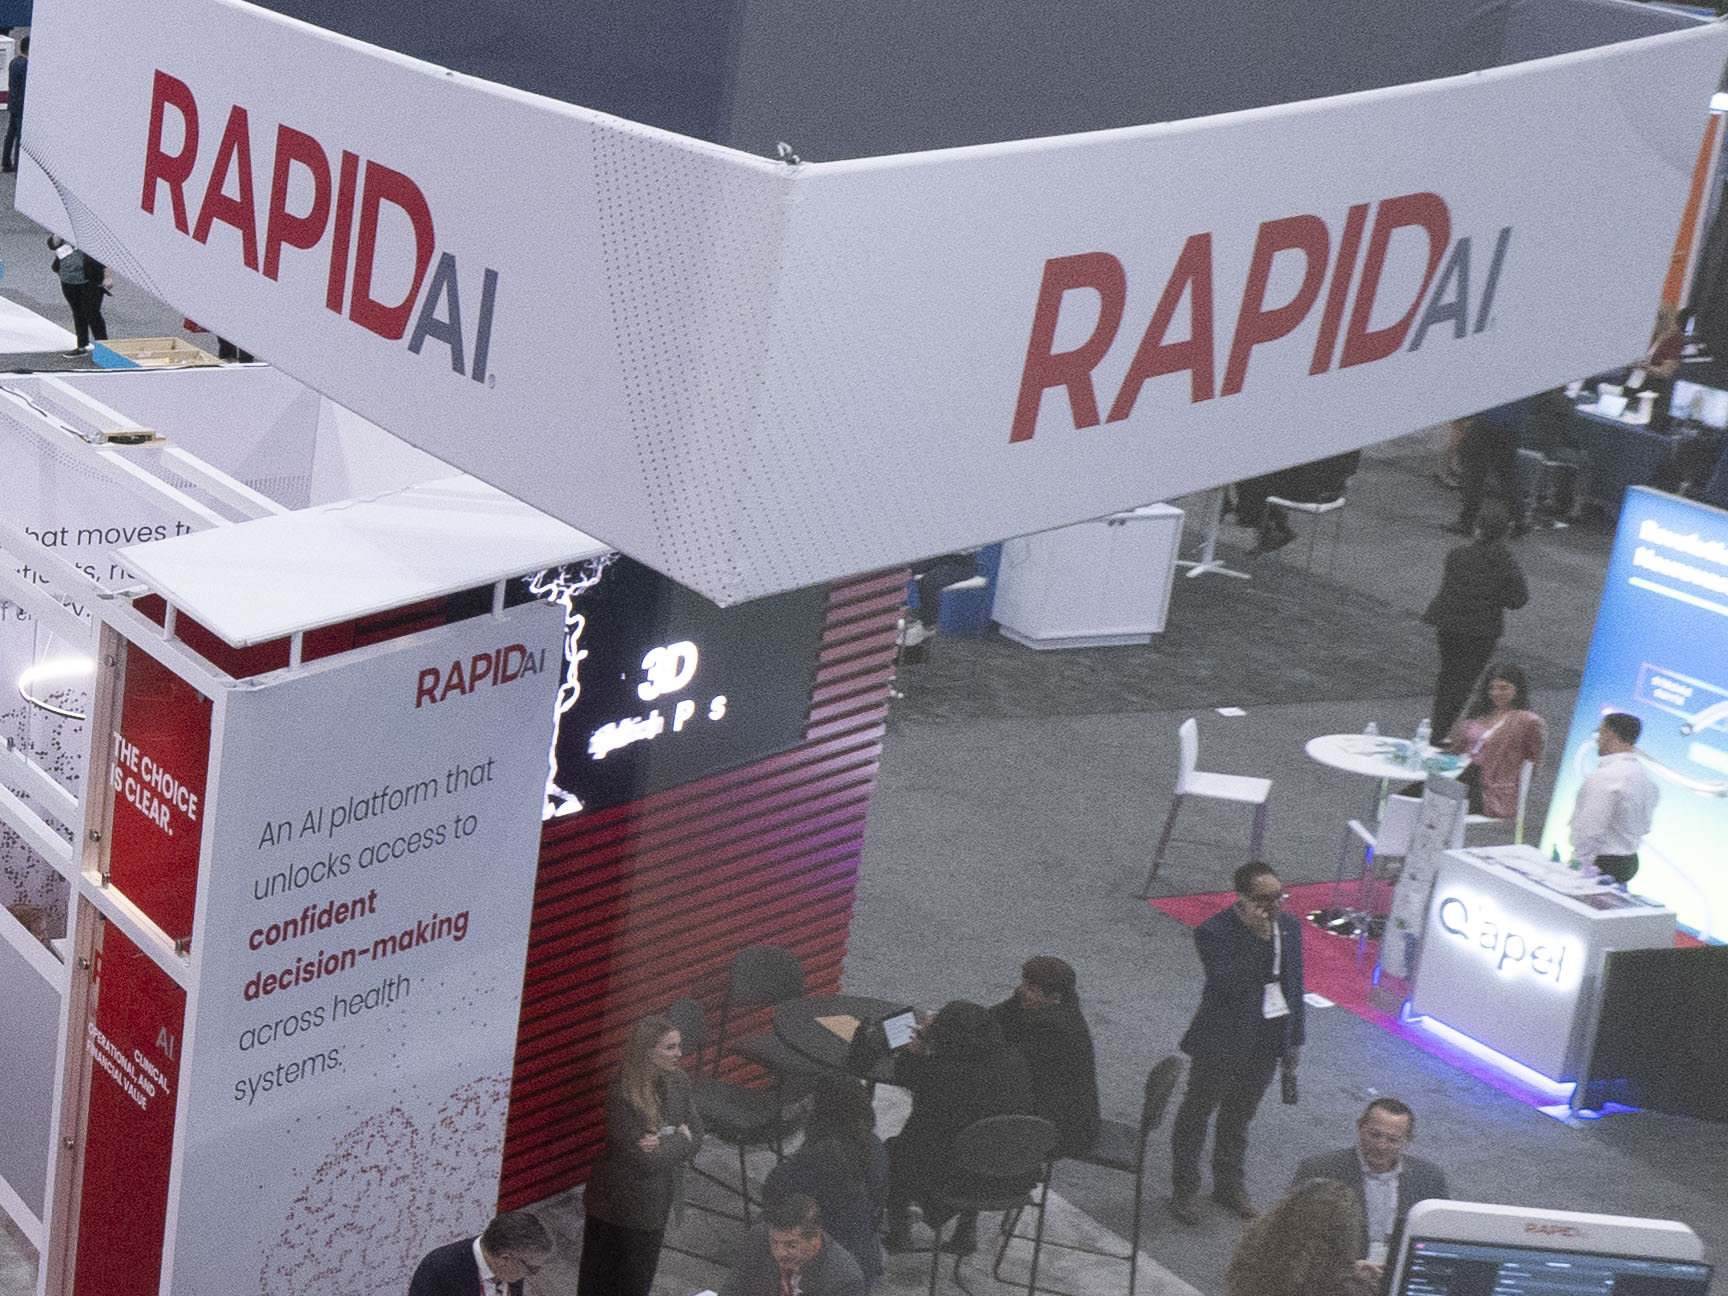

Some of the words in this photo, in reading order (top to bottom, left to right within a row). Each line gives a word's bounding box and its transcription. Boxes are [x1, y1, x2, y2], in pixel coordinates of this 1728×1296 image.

[140, 67, 500, 385] RAPIDAI
[1008, 191, 1513, 445] RAPIDAI
[77, 527, 167, 546] moves
[415, 642, 547, 709] RAPIDAI
[637, 640, 700, 701] 3D
[109, 762, 123, 793] IS
[124, 776, 174, 837] CLEAR.
[112, 731, 139, 773] THE
[141, 755, 198, 822] CHOICE
[257, 817, 296, 852] An
[299, 802, 324, 838] AI
[327, 765, 439, 838] platform
[446, 754, 496, 792] that
[251, 854, 352, 906] unlocks
[356, 822, 447, 871] access
[449, 811, 479, 847] to
[242, 906, 470, 1003] decision-making
[246, 888, 379, 954] confident
[237, 1006, 329, 1054] across
[334, 972, 412, 1029] health
[86, 1040, 124, 1094] FINANCIAL
[123, 1077, 148, 1111] VALUE
[87, 1021, 138, 1082] OPERATIONAL,
[137, 1070, 156, 1099] AND
[133, 1047, 171, 1095] CLINICAL,
[233, 1044, 345, 1105] systems.
